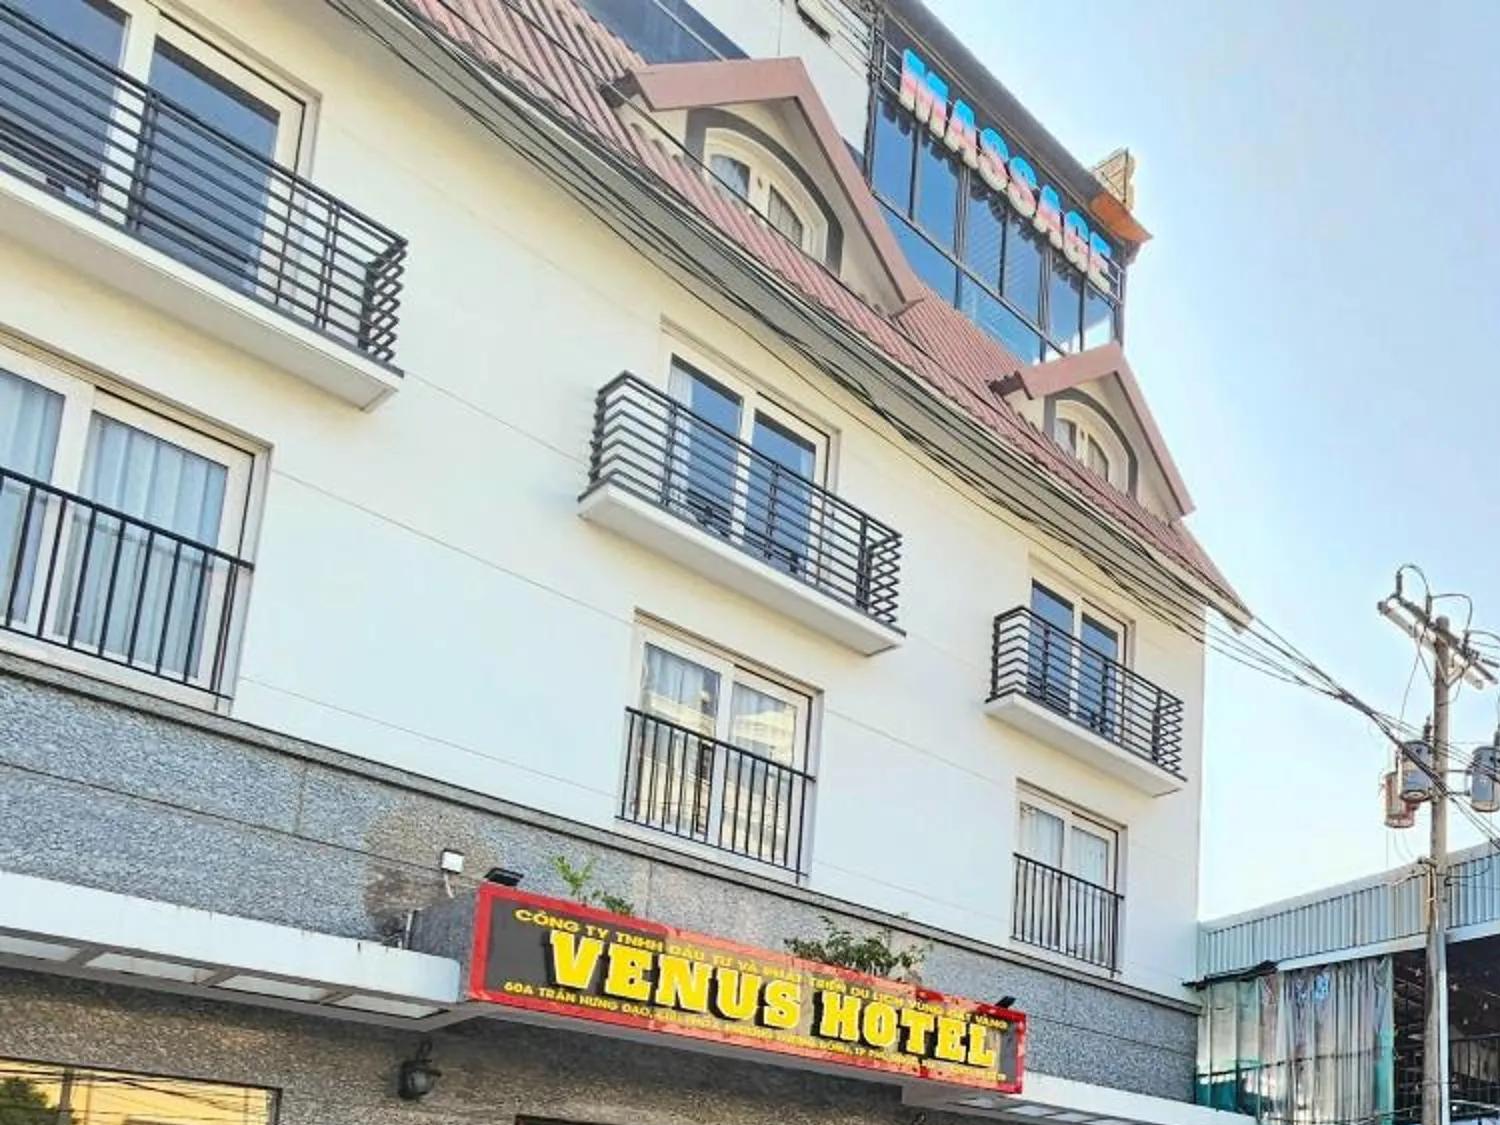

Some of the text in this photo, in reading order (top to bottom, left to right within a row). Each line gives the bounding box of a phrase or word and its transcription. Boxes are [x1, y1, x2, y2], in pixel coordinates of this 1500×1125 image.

[900, 48, 1112, 293] MASSAGE
[515, 908, 581, 933] CÔNG
[586, 925, 609, 940] TY
[615, 931, 663, 953] TNHH
[503, 982, 534, 999] 60A
[549, 929, 998, 1068] VENUS HOTEL
